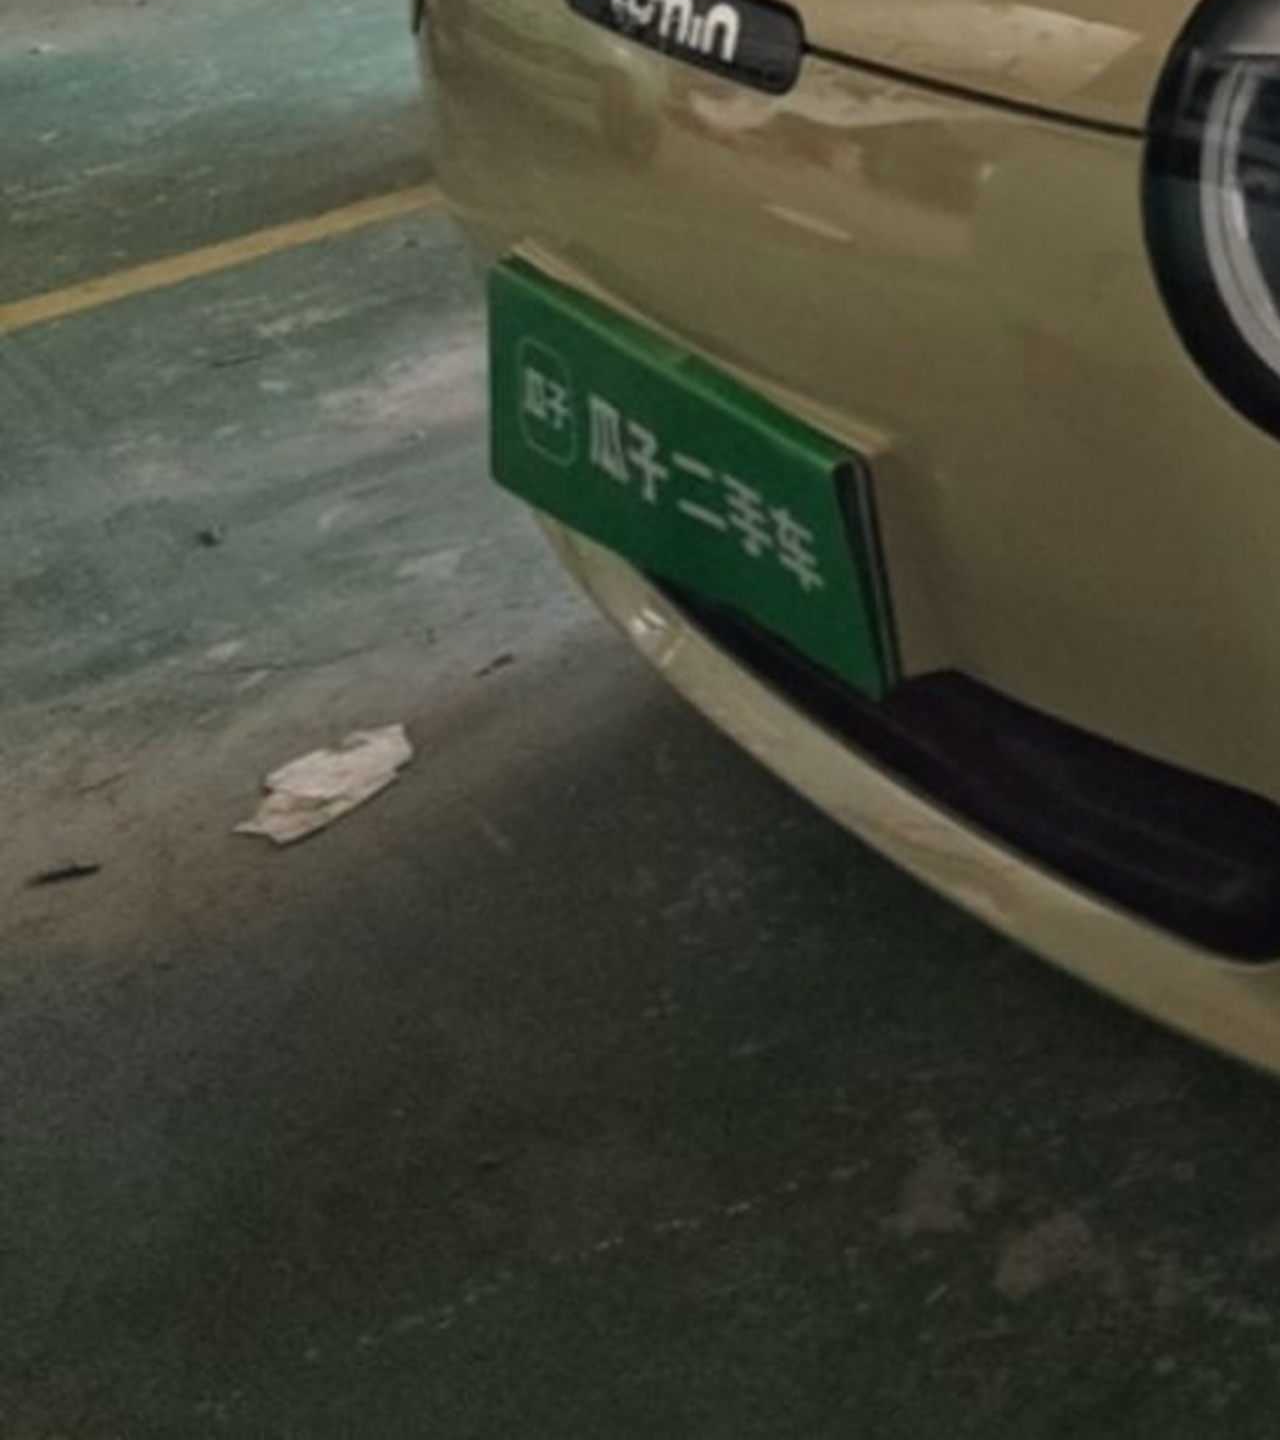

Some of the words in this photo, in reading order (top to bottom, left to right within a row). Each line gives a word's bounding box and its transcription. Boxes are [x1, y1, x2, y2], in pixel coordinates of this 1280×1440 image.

[589, 392, 826, 592] 瓜子二手车
